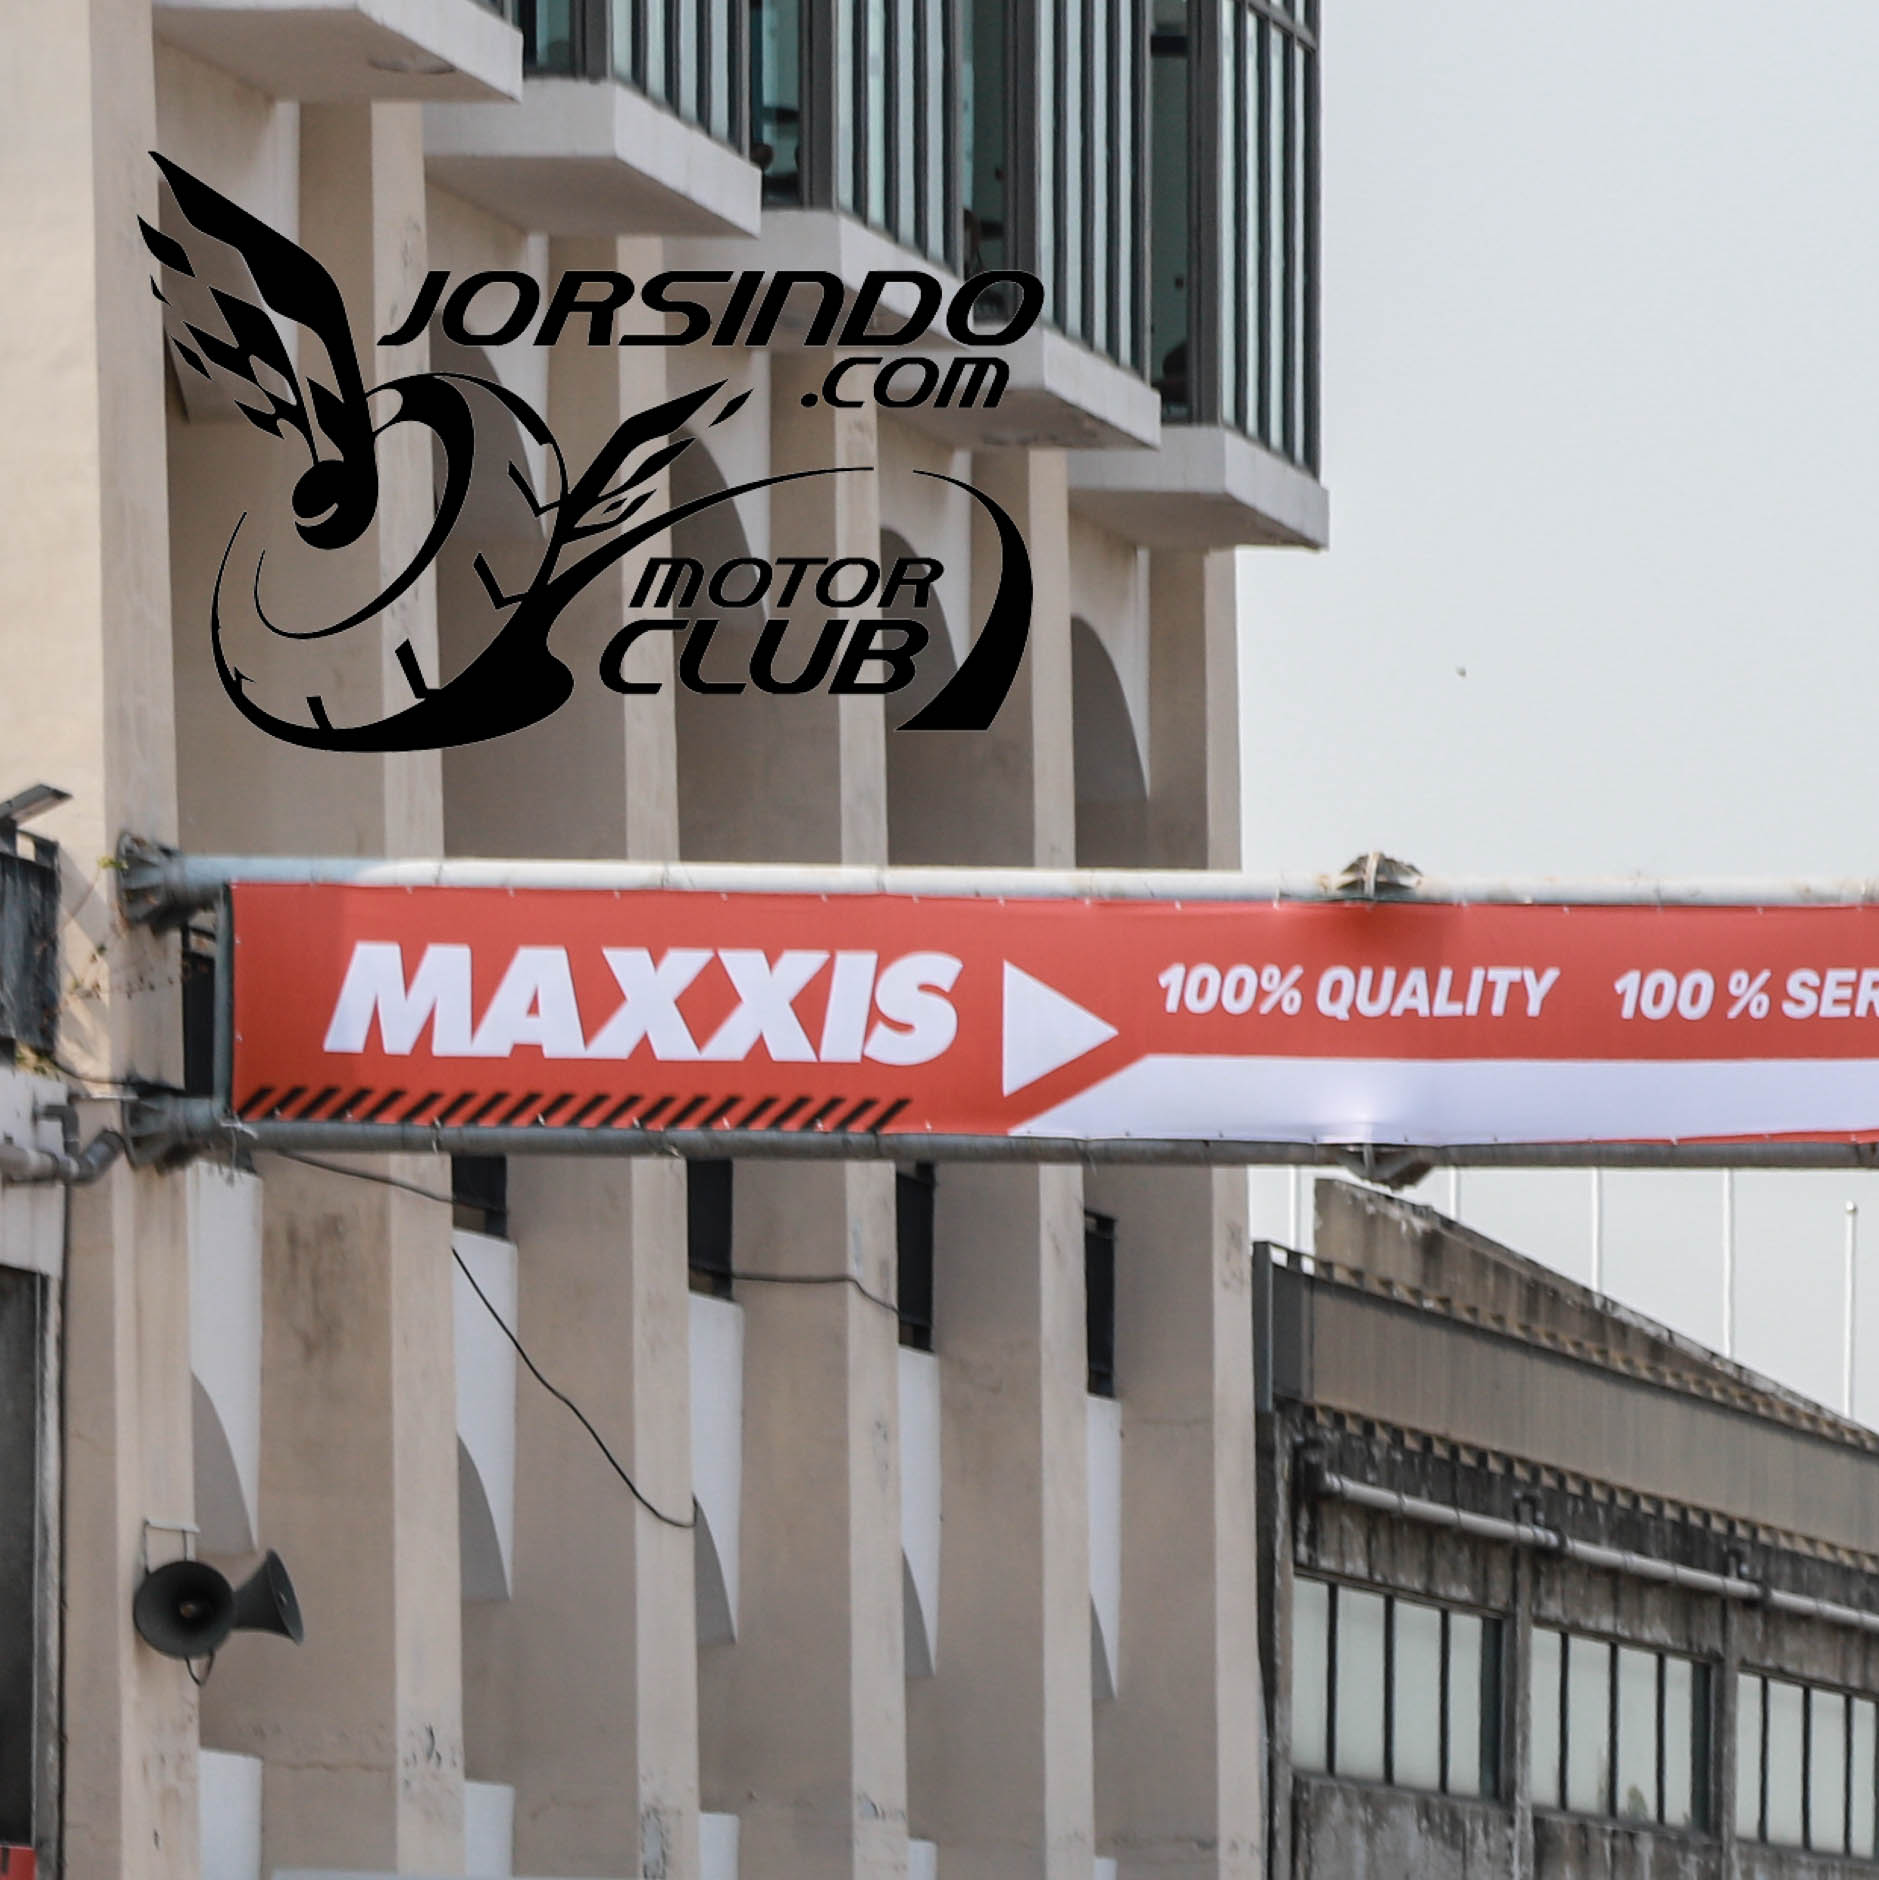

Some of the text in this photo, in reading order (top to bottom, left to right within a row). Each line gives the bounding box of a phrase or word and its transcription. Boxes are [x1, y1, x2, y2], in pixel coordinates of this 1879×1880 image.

[323, 942, 964, 1066] MAXXIS
[1158, 963, 1561, 1022] 100% QUALITY
